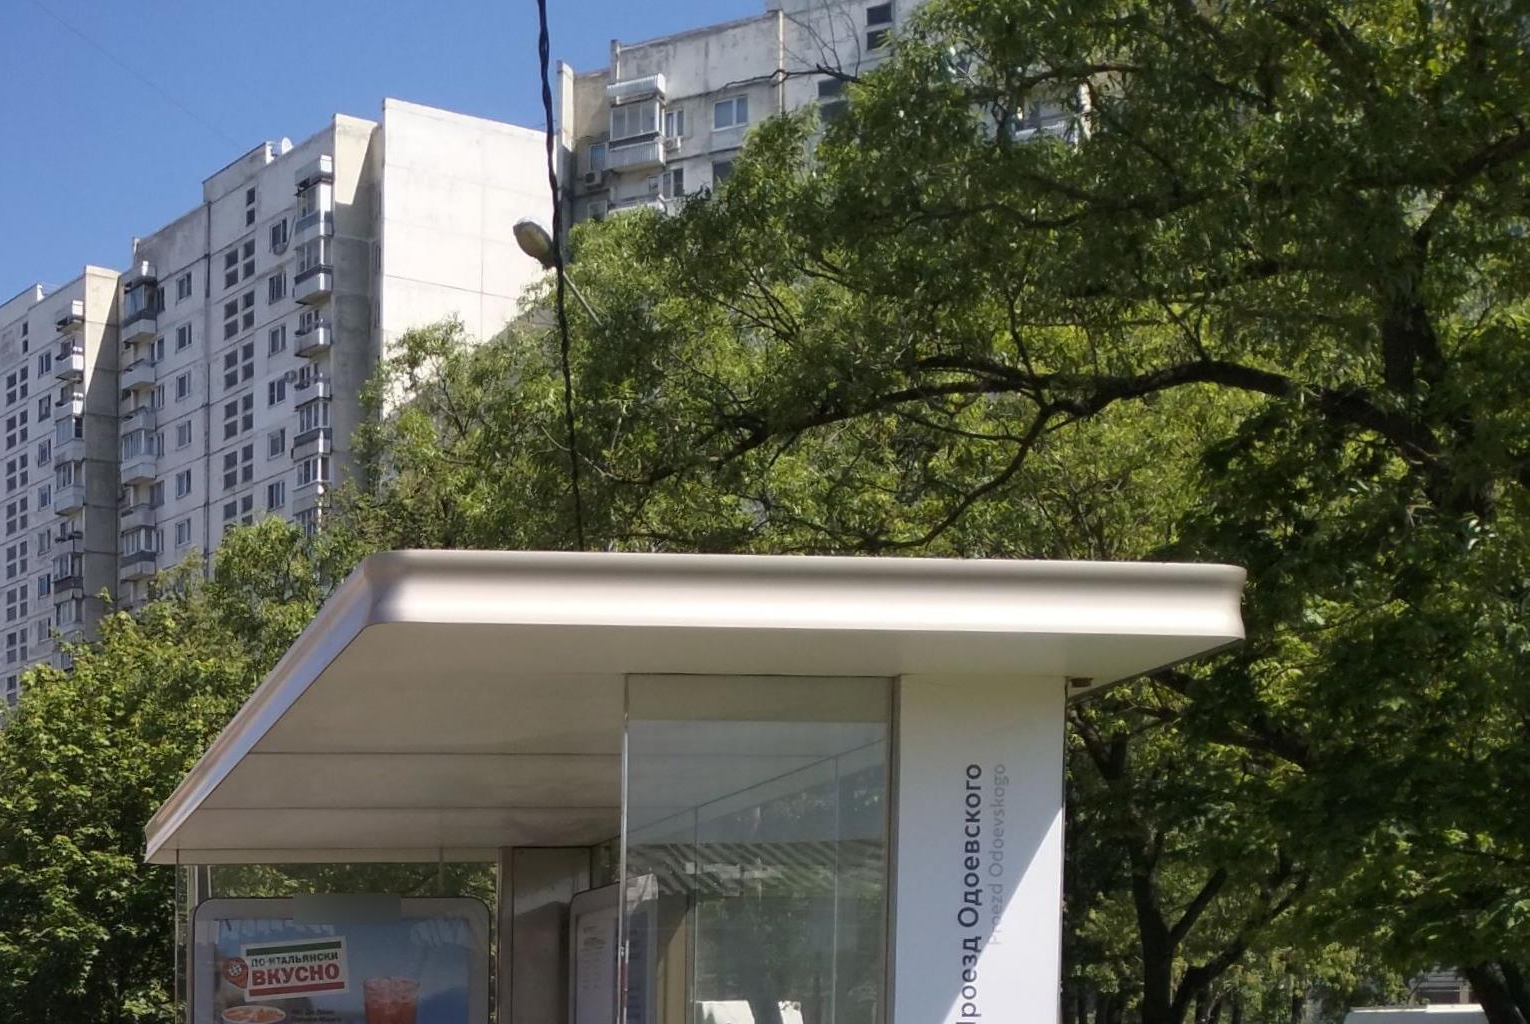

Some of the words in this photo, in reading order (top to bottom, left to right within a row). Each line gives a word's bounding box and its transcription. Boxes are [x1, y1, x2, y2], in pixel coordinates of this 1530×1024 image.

[957, 763, 983, 928] Одоевского
[989, 763, 1010, 878] Odoevskogo
[989, 883, 1006, 945] Proezd
[250, 951, 339, 968] ПО-ИТАЛЬЯНСКИ
[251, 962, 340, 987] ВКУСНО
